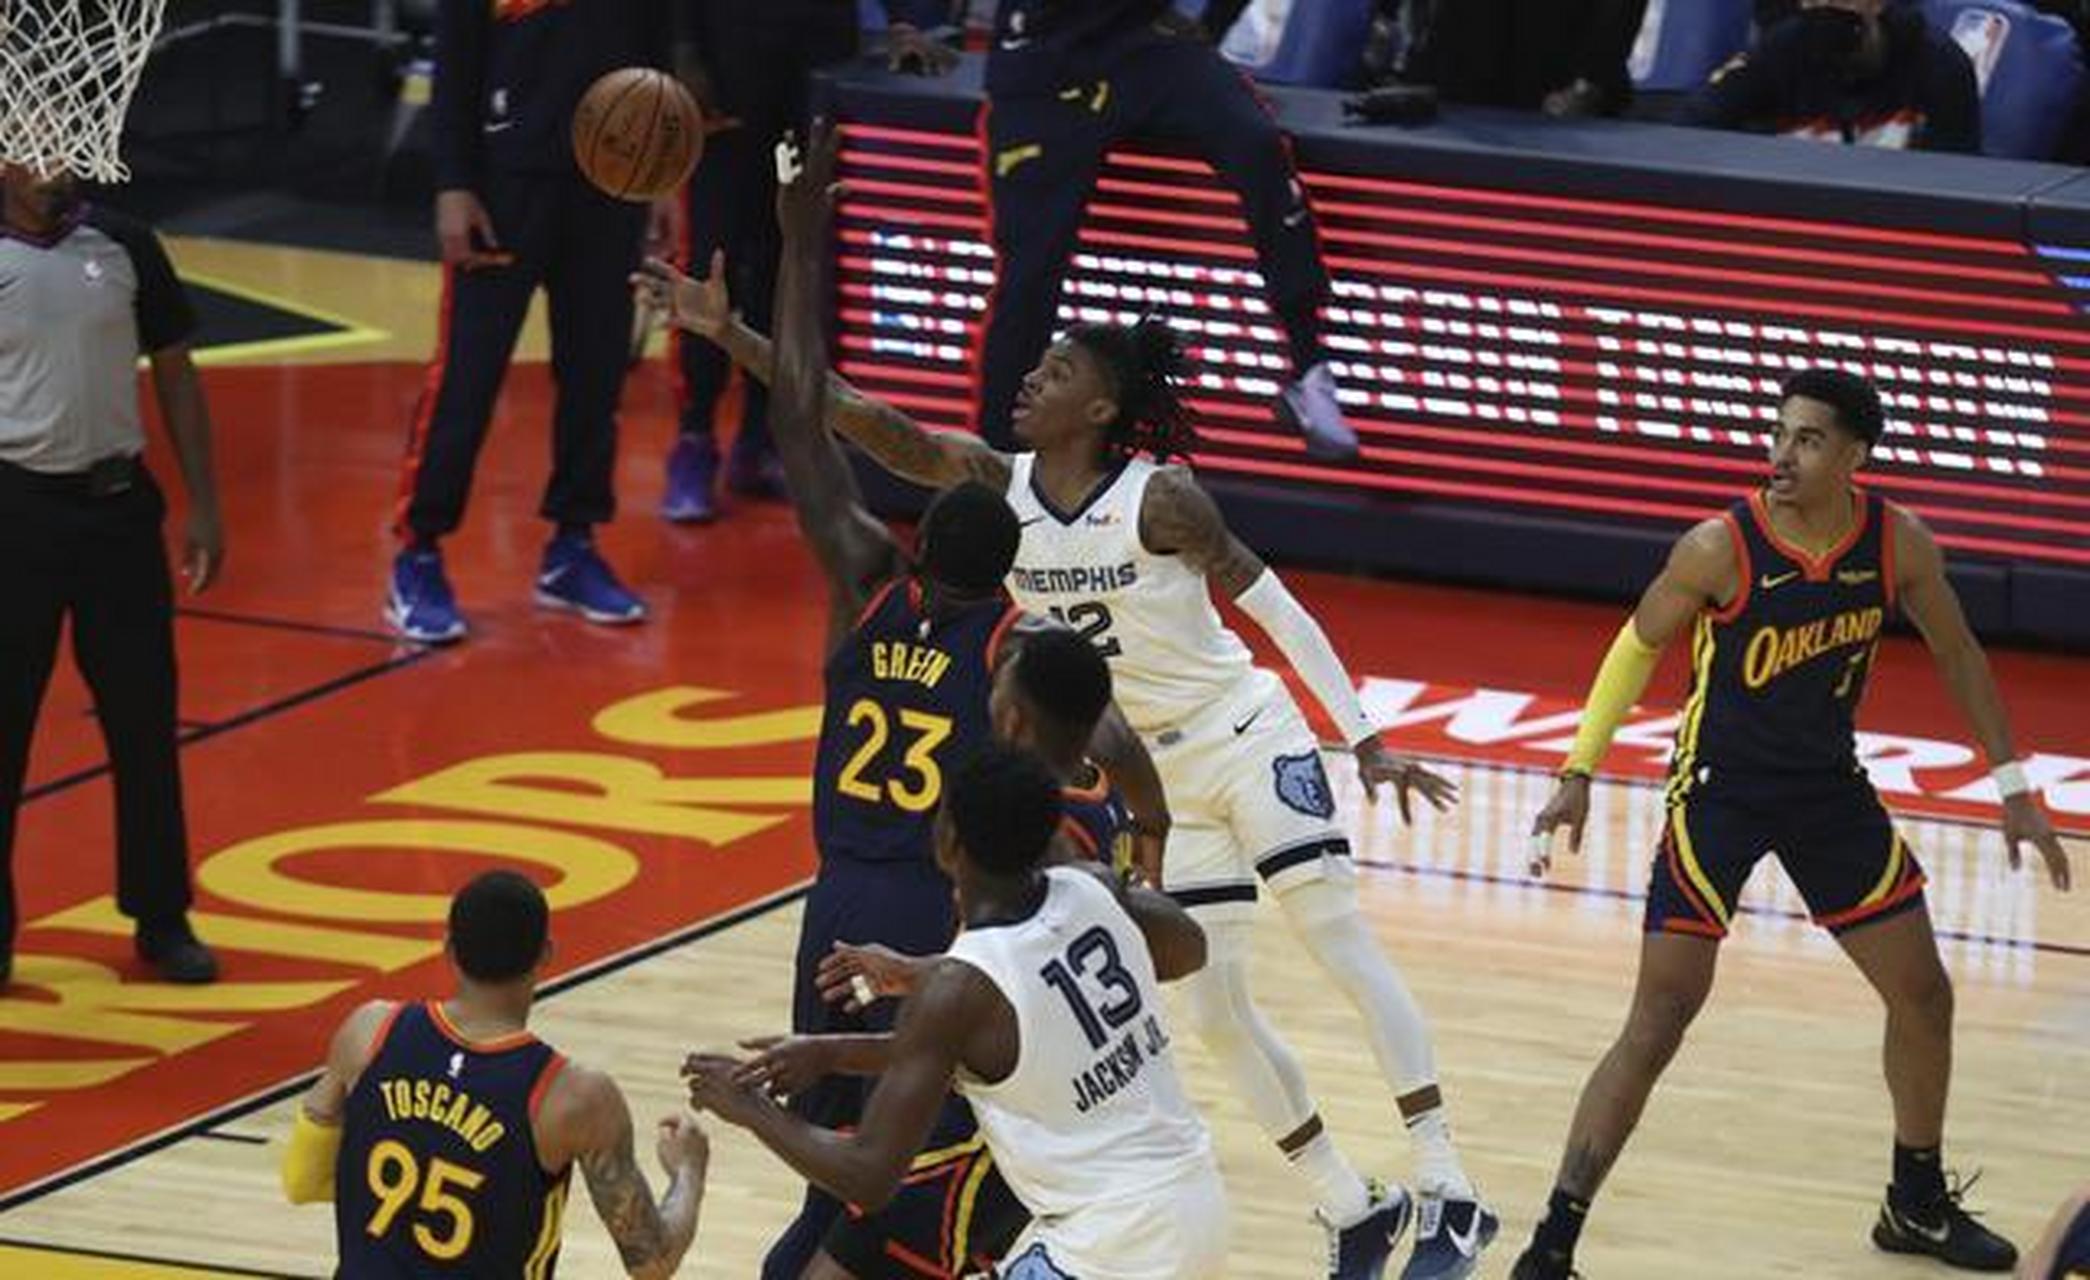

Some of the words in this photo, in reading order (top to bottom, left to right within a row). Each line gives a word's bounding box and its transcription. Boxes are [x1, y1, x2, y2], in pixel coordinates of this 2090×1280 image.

[1743, 605, 1884, 689] OAKLAND
[837, 697, 953, 812] 23
[1039, 924, 1144, 1051] 13
[379, 1077, 506, 1153] TOSCANO
[365, 1138, 486, 1260] 95
